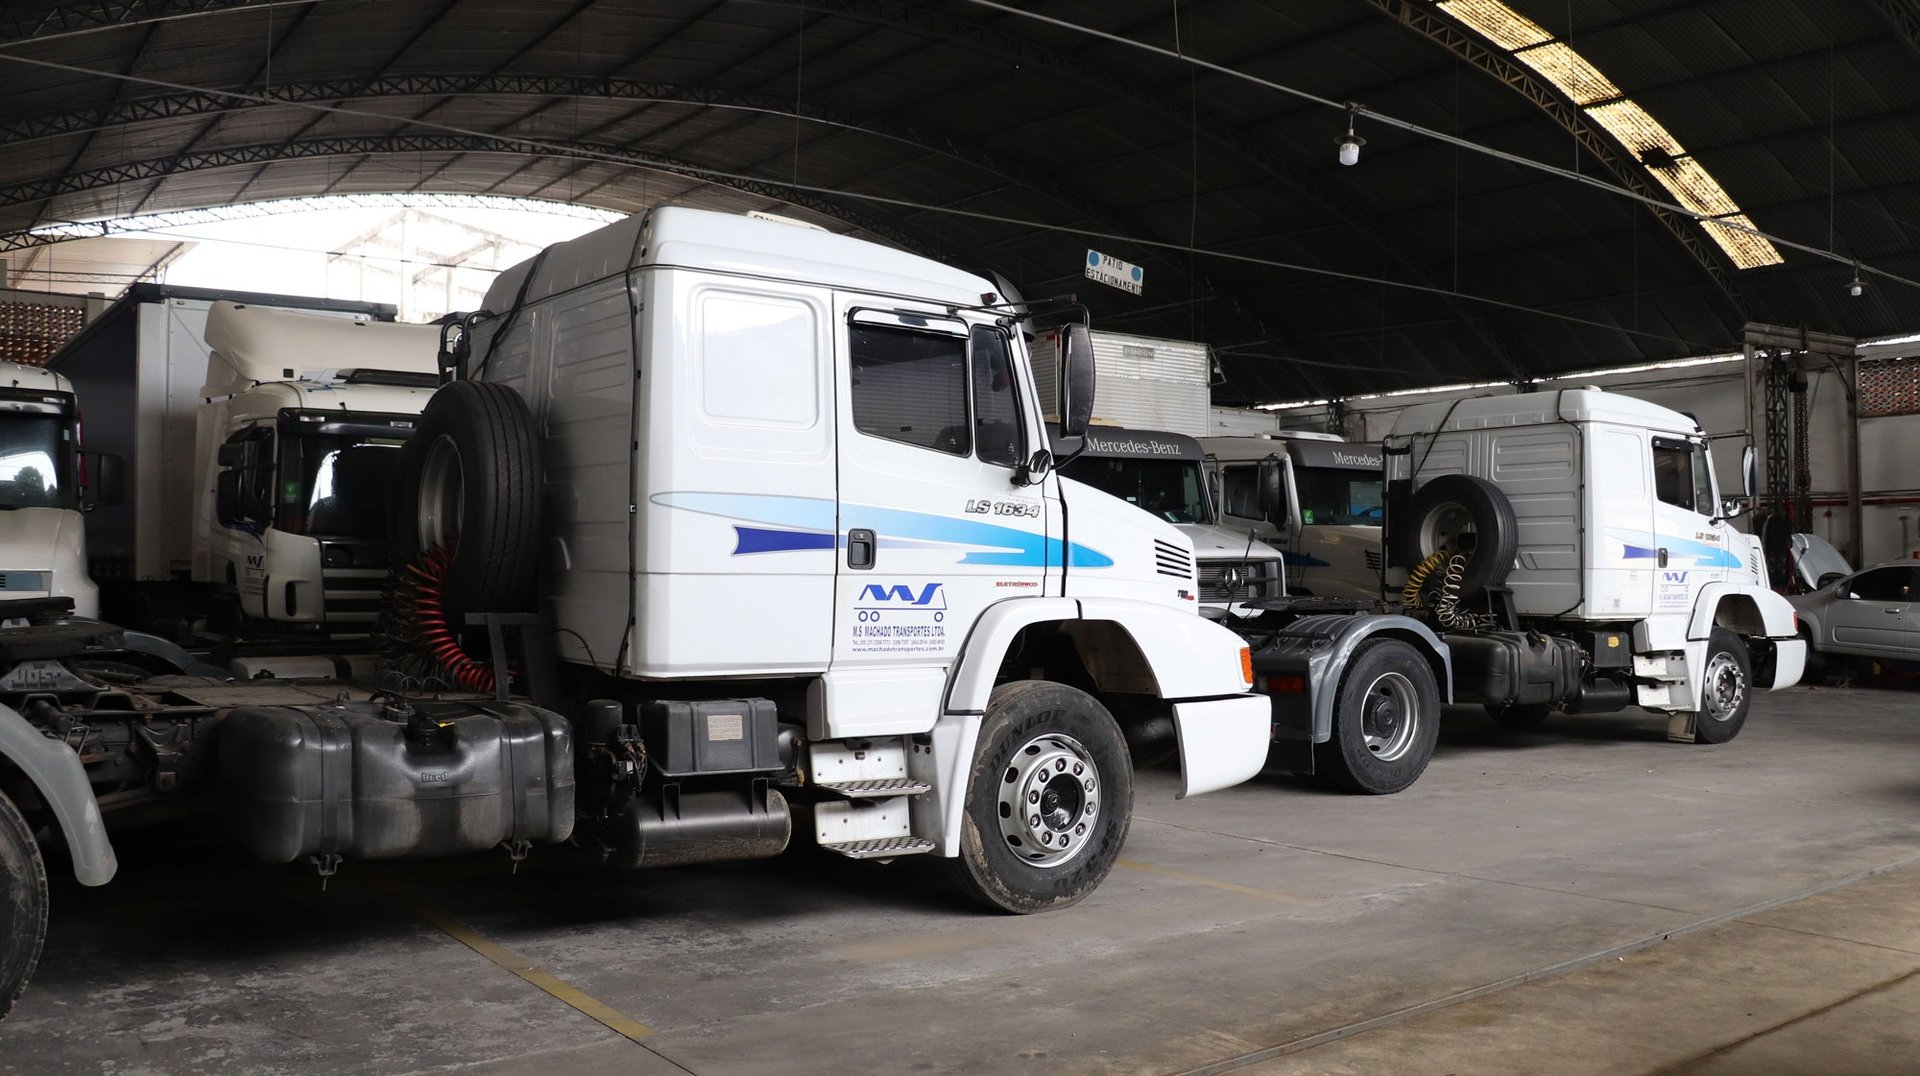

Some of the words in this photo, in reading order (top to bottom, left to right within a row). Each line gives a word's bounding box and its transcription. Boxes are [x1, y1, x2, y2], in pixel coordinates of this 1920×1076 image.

[1103, 255, 1123, 271] PATIO
[1087, 438, 1182, 455] Mercedes-Benz
[965, 499, 991, 514] LS
[994, 502, 1041, 518] 1634
[864, 626, 892, 637] MACHADO
[893, 626, 930, 637] TRANSPORTES
[991, 708, 1067, 771] DUNLOP
